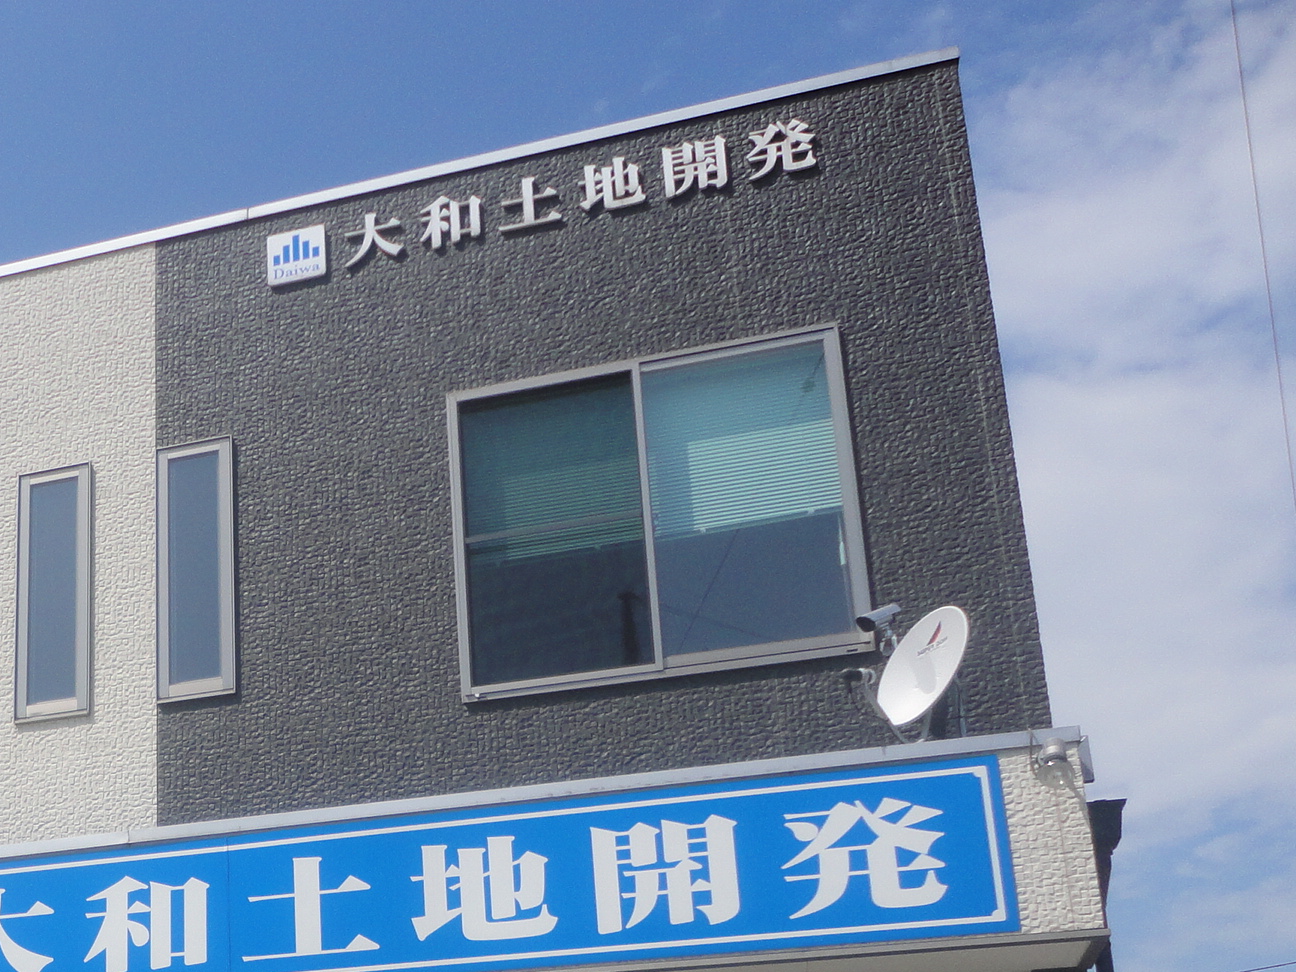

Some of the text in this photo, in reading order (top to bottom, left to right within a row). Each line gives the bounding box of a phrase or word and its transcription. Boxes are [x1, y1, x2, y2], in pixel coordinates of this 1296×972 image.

[344, 117, 817, 269] 大和土地開発
[273, 263, 320, 280] Daiwa
